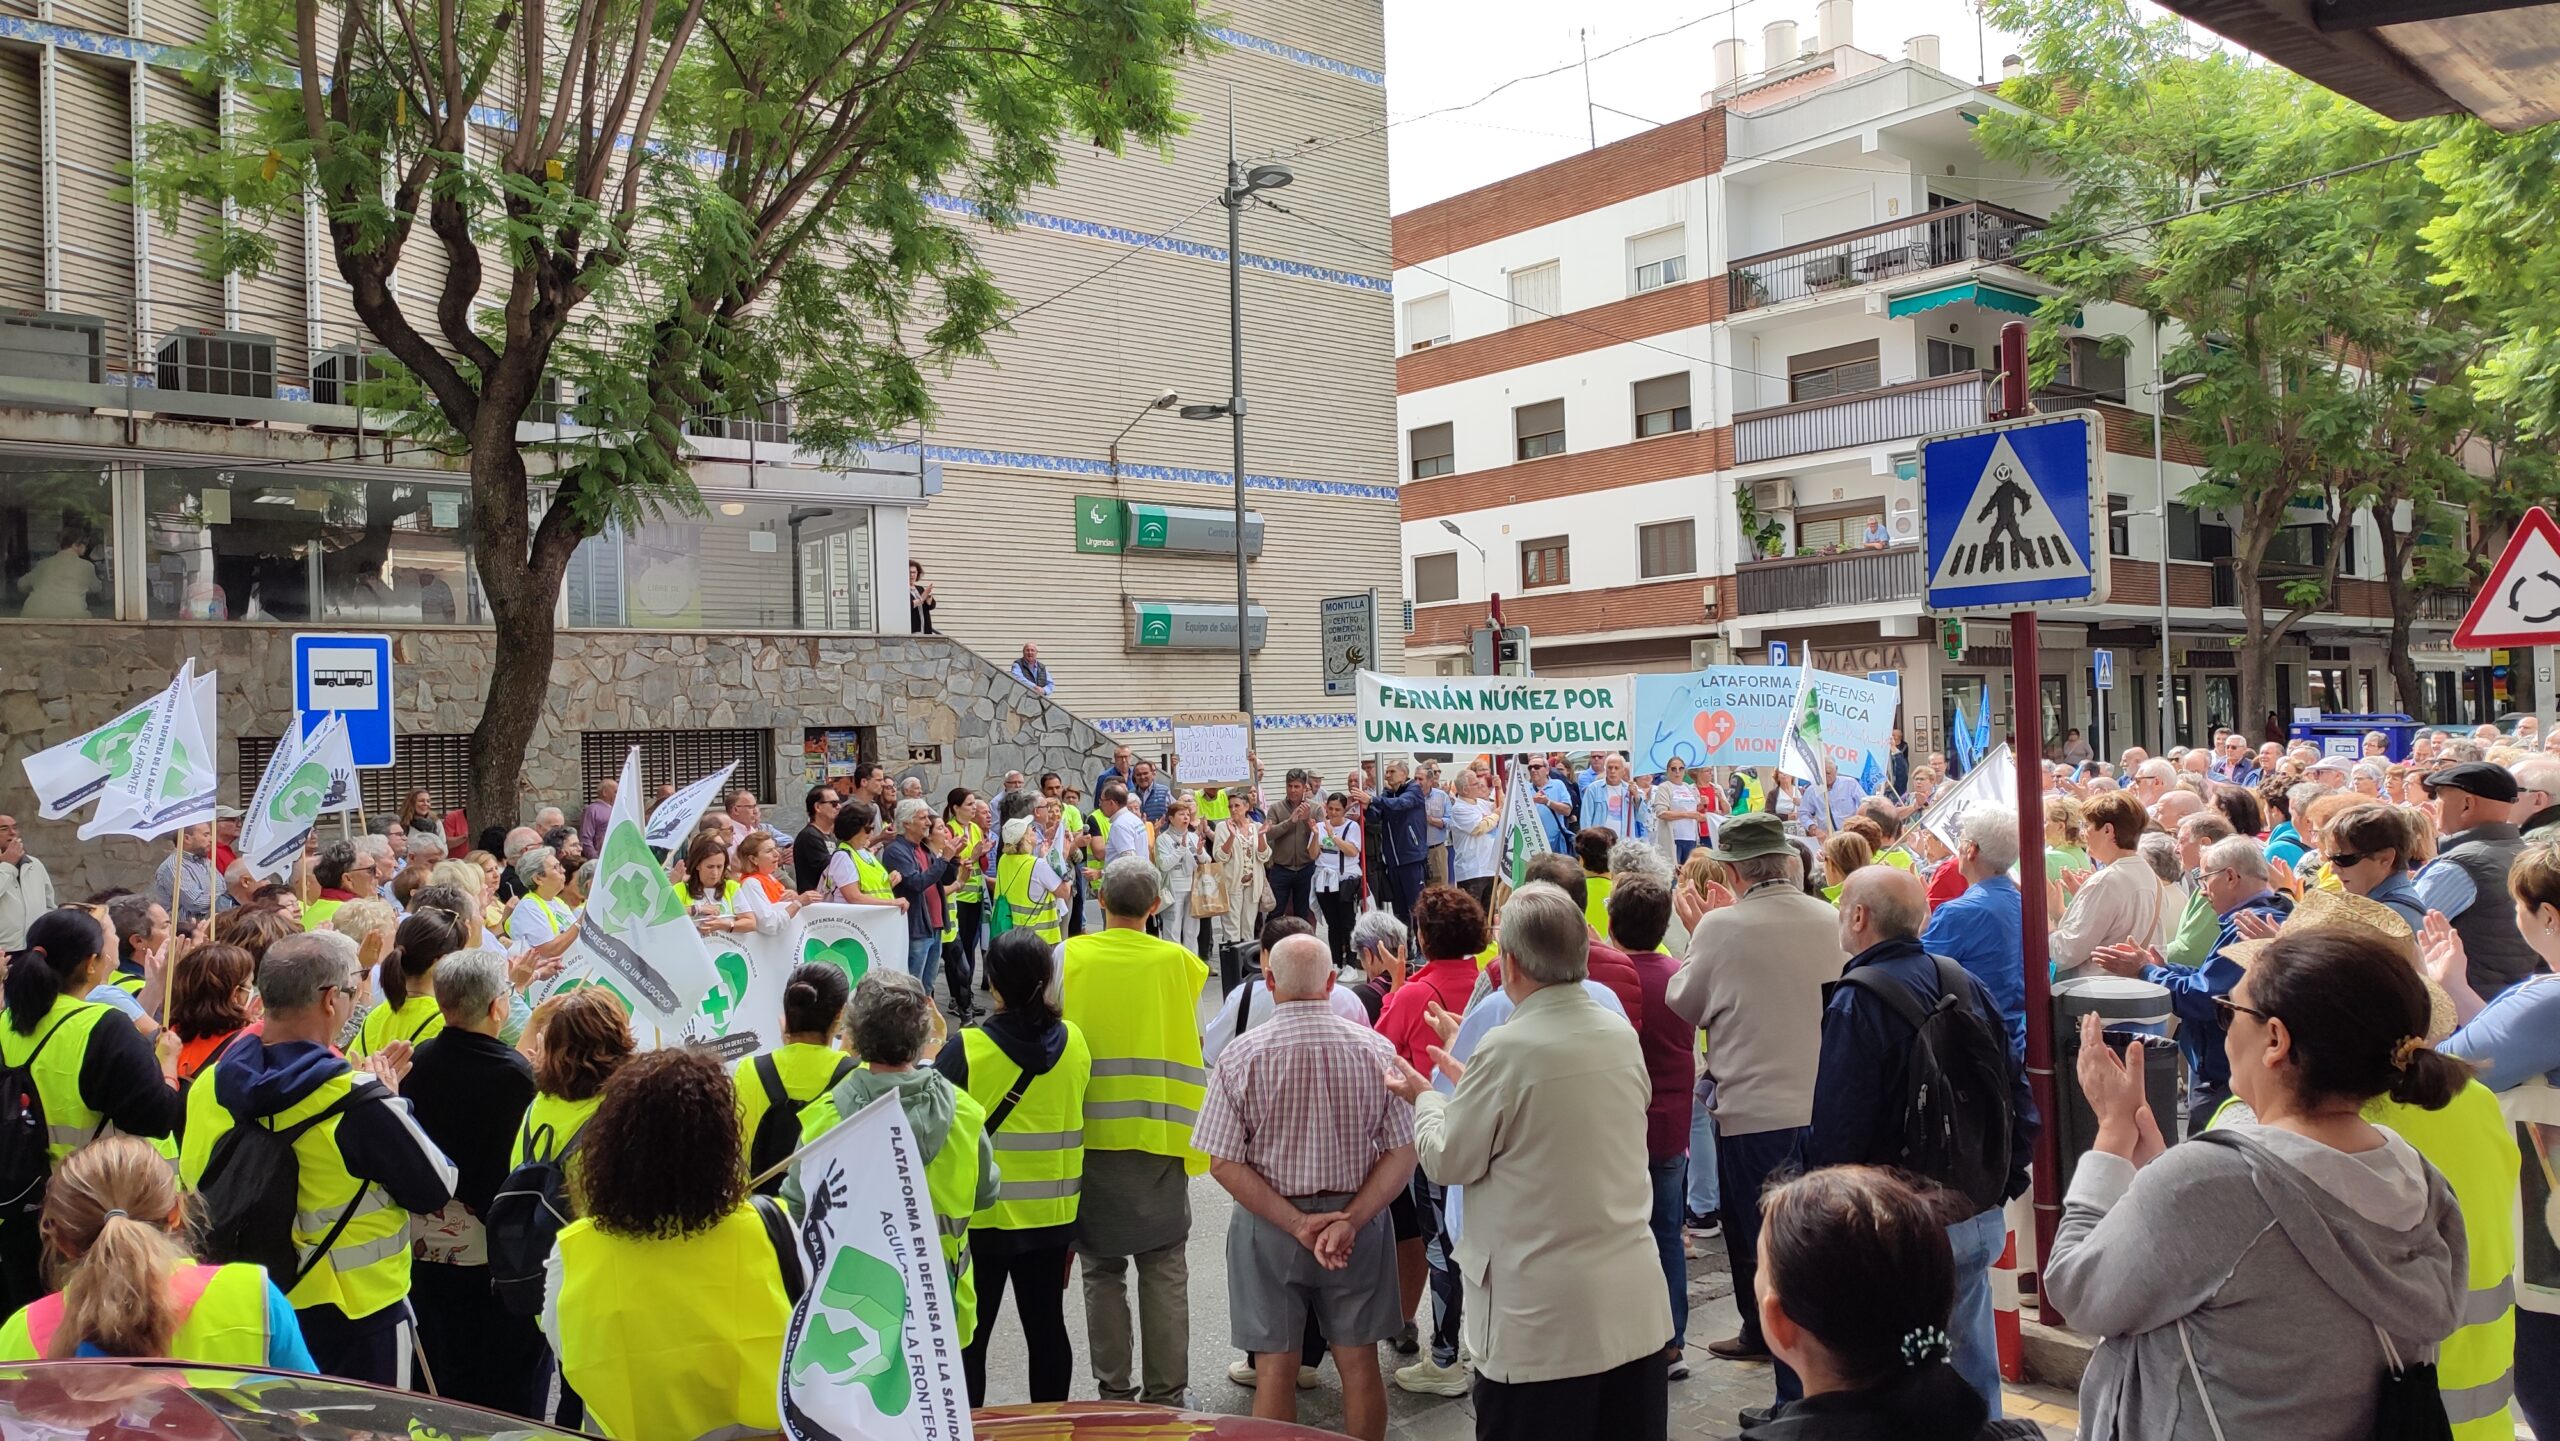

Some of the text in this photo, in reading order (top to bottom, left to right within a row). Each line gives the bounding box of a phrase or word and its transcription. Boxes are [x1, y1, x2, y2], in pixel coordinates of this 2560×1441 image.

[1085, 537, 1115, 548] Urgencias
[1207, 527, 1230, 538] Centro
[1326, 600, 1365, 612] MONTILLA
[1185, 621, 1208, 635] Equipo
[1210, 622, 1218, 632] de
[1220, 622, 1238, 633] Salud
[1328, 625, 1365, 634] COMERCIAL
[1333, 616, 1358, 625] CENTRO
[1333, 634, 1360, 643] ABIERTO
[1380, 684, 1614, 711] FERNÁN NÚÑEZ POR
[1364, 716, 1628, 744] UNA SANIDAD PÚBLICA
[127, 756, 146, 796] FRONTER
[618, 958, 632, 971] NO
[630, 967, 642, 981] UN
[890, 1126, 921, 1233] PLATAFORMA
[912, 1237, 928, 1258] EN
[918, 1262, 942, 1333] DEFENSA
[795, 1305, 806, 1326] UN
[905, 1326, 920, 1349] LA
[933, 1338, 947, 1358] DE
[937, 1362, 951, 1382] LA
[909, 1354, 938, 1441] FRONTER
[788, 1419, 805, 1438] NO
